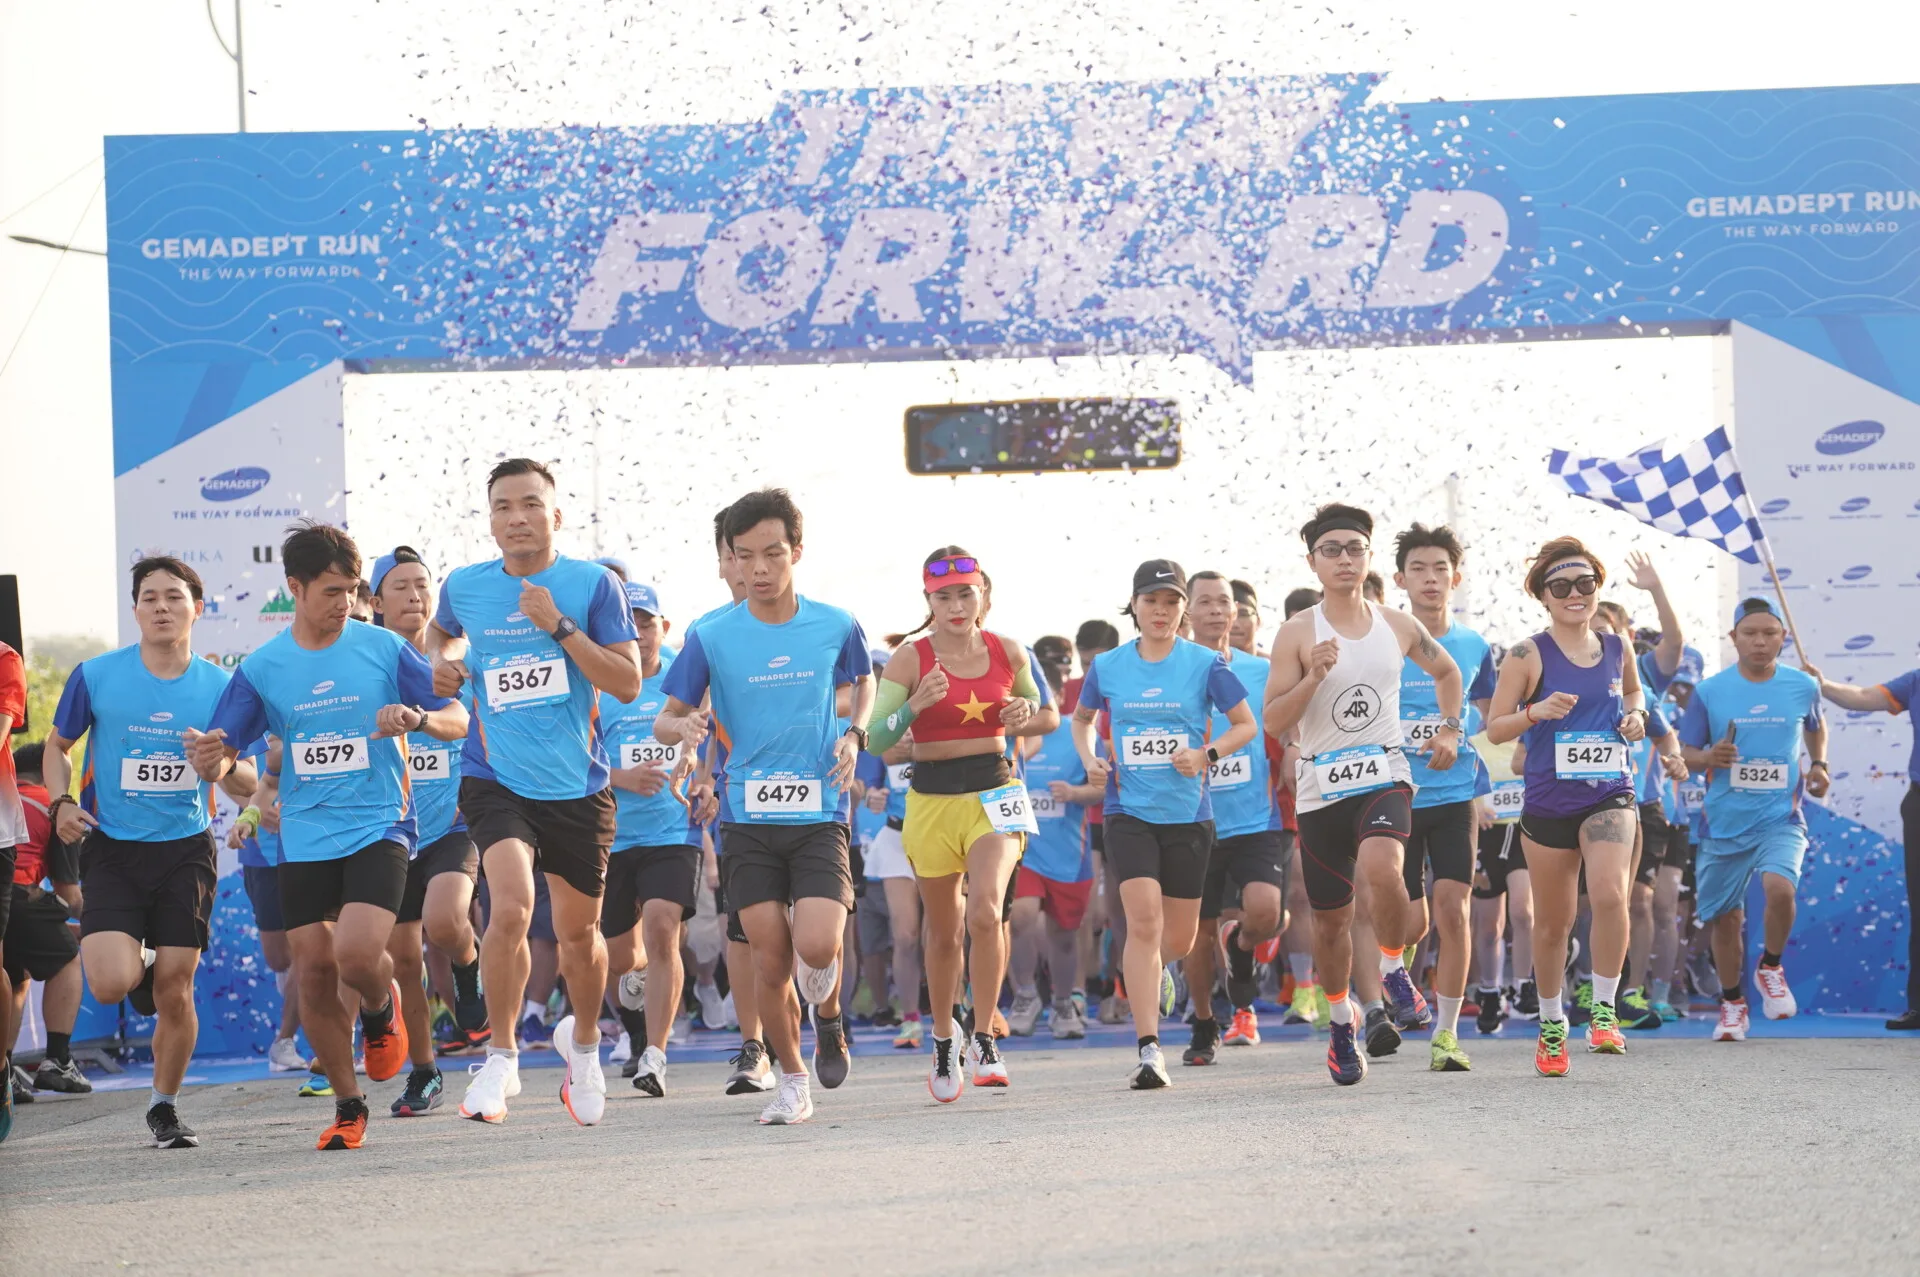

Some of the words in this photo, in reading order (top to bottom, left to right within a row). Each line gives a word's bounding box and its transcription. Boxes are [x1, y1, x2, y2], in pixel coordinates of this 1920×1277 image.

[1686, 192, 1855, 218] GEMADEPT
[1865, 190, 1920, 212] RUN
[1724, 225, 1756, 238] THE
[1764, 224, 1802, 237] WAY
[1810, 221, 1899, 235] FORWARD
[141, 236, 308, 259] GEMADEPT
[318, 234, 381, 256] RUN
[179, 267, 211, 280] THE
[217, 267, 257, 279] WAY
[264, 265, 350, 279] FORWARD
[1820, 432, 1882, 444] GEMADEPT
[1787, 464, 1812, 473] THE
[1817, 463, 1844, 472] WAY
[1849, 461, 1916, 471] FORWARD
[204, 478, 267, 490] GEMADEPT
[172, 510, 197, 520] THE
[498, 666, 552, 692] 5367
[748, 673, 794, 683] GEMADEPT
[797, 670, 814, 678] RUN
[293, 697, 339, 711] GEMADEPT
[341, 695, 359, 703] RUN
[128, 725, 174, 736] GEMADEPT
[304, 743, 354, 765] 6579
[631, 747, 675, 763] 5320
[1132, 739, 1178, 756] 5432
[1567, 747, 1612, 764] 5427
[137, 764, 185, 782] 5137
[1210, 762, 1242, 778] 964
[1328, 760, 1379, 783] 6474
[1739, 767, 1779, 782] 5324
[757, 785, 809, 803] 6479
